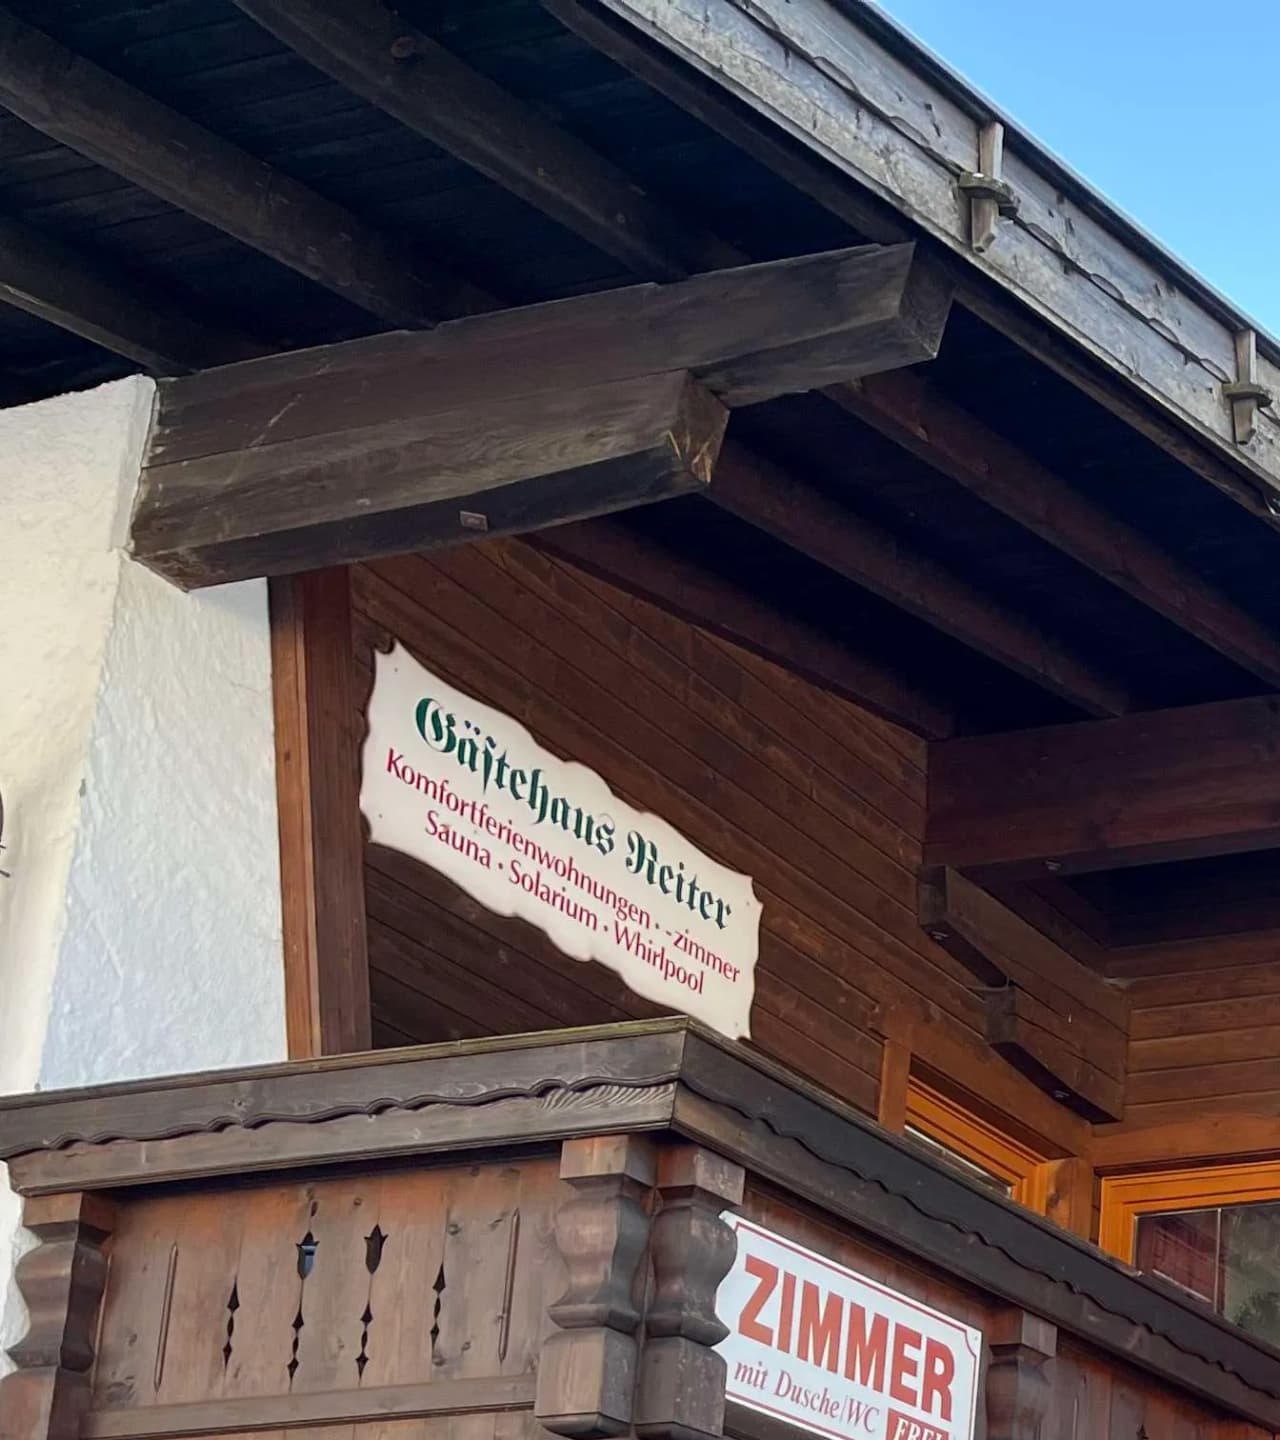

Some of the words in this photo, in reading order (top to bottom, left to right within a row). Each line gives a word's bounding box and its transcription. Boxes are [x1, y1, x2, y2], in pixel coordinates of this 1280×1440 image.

[386, 747, 652, 931] Komfortferienwohnungen
[424, 809, 492, 870] Sauna
[508, 858, 599, 933] Solarium
[613, 918, 706, 996] Whirlpool
[625, 829, 733, 931] Reiter
[733, 1359, 769, 1391] mit
[737, 1252, 956, 1423] ZIMMER
